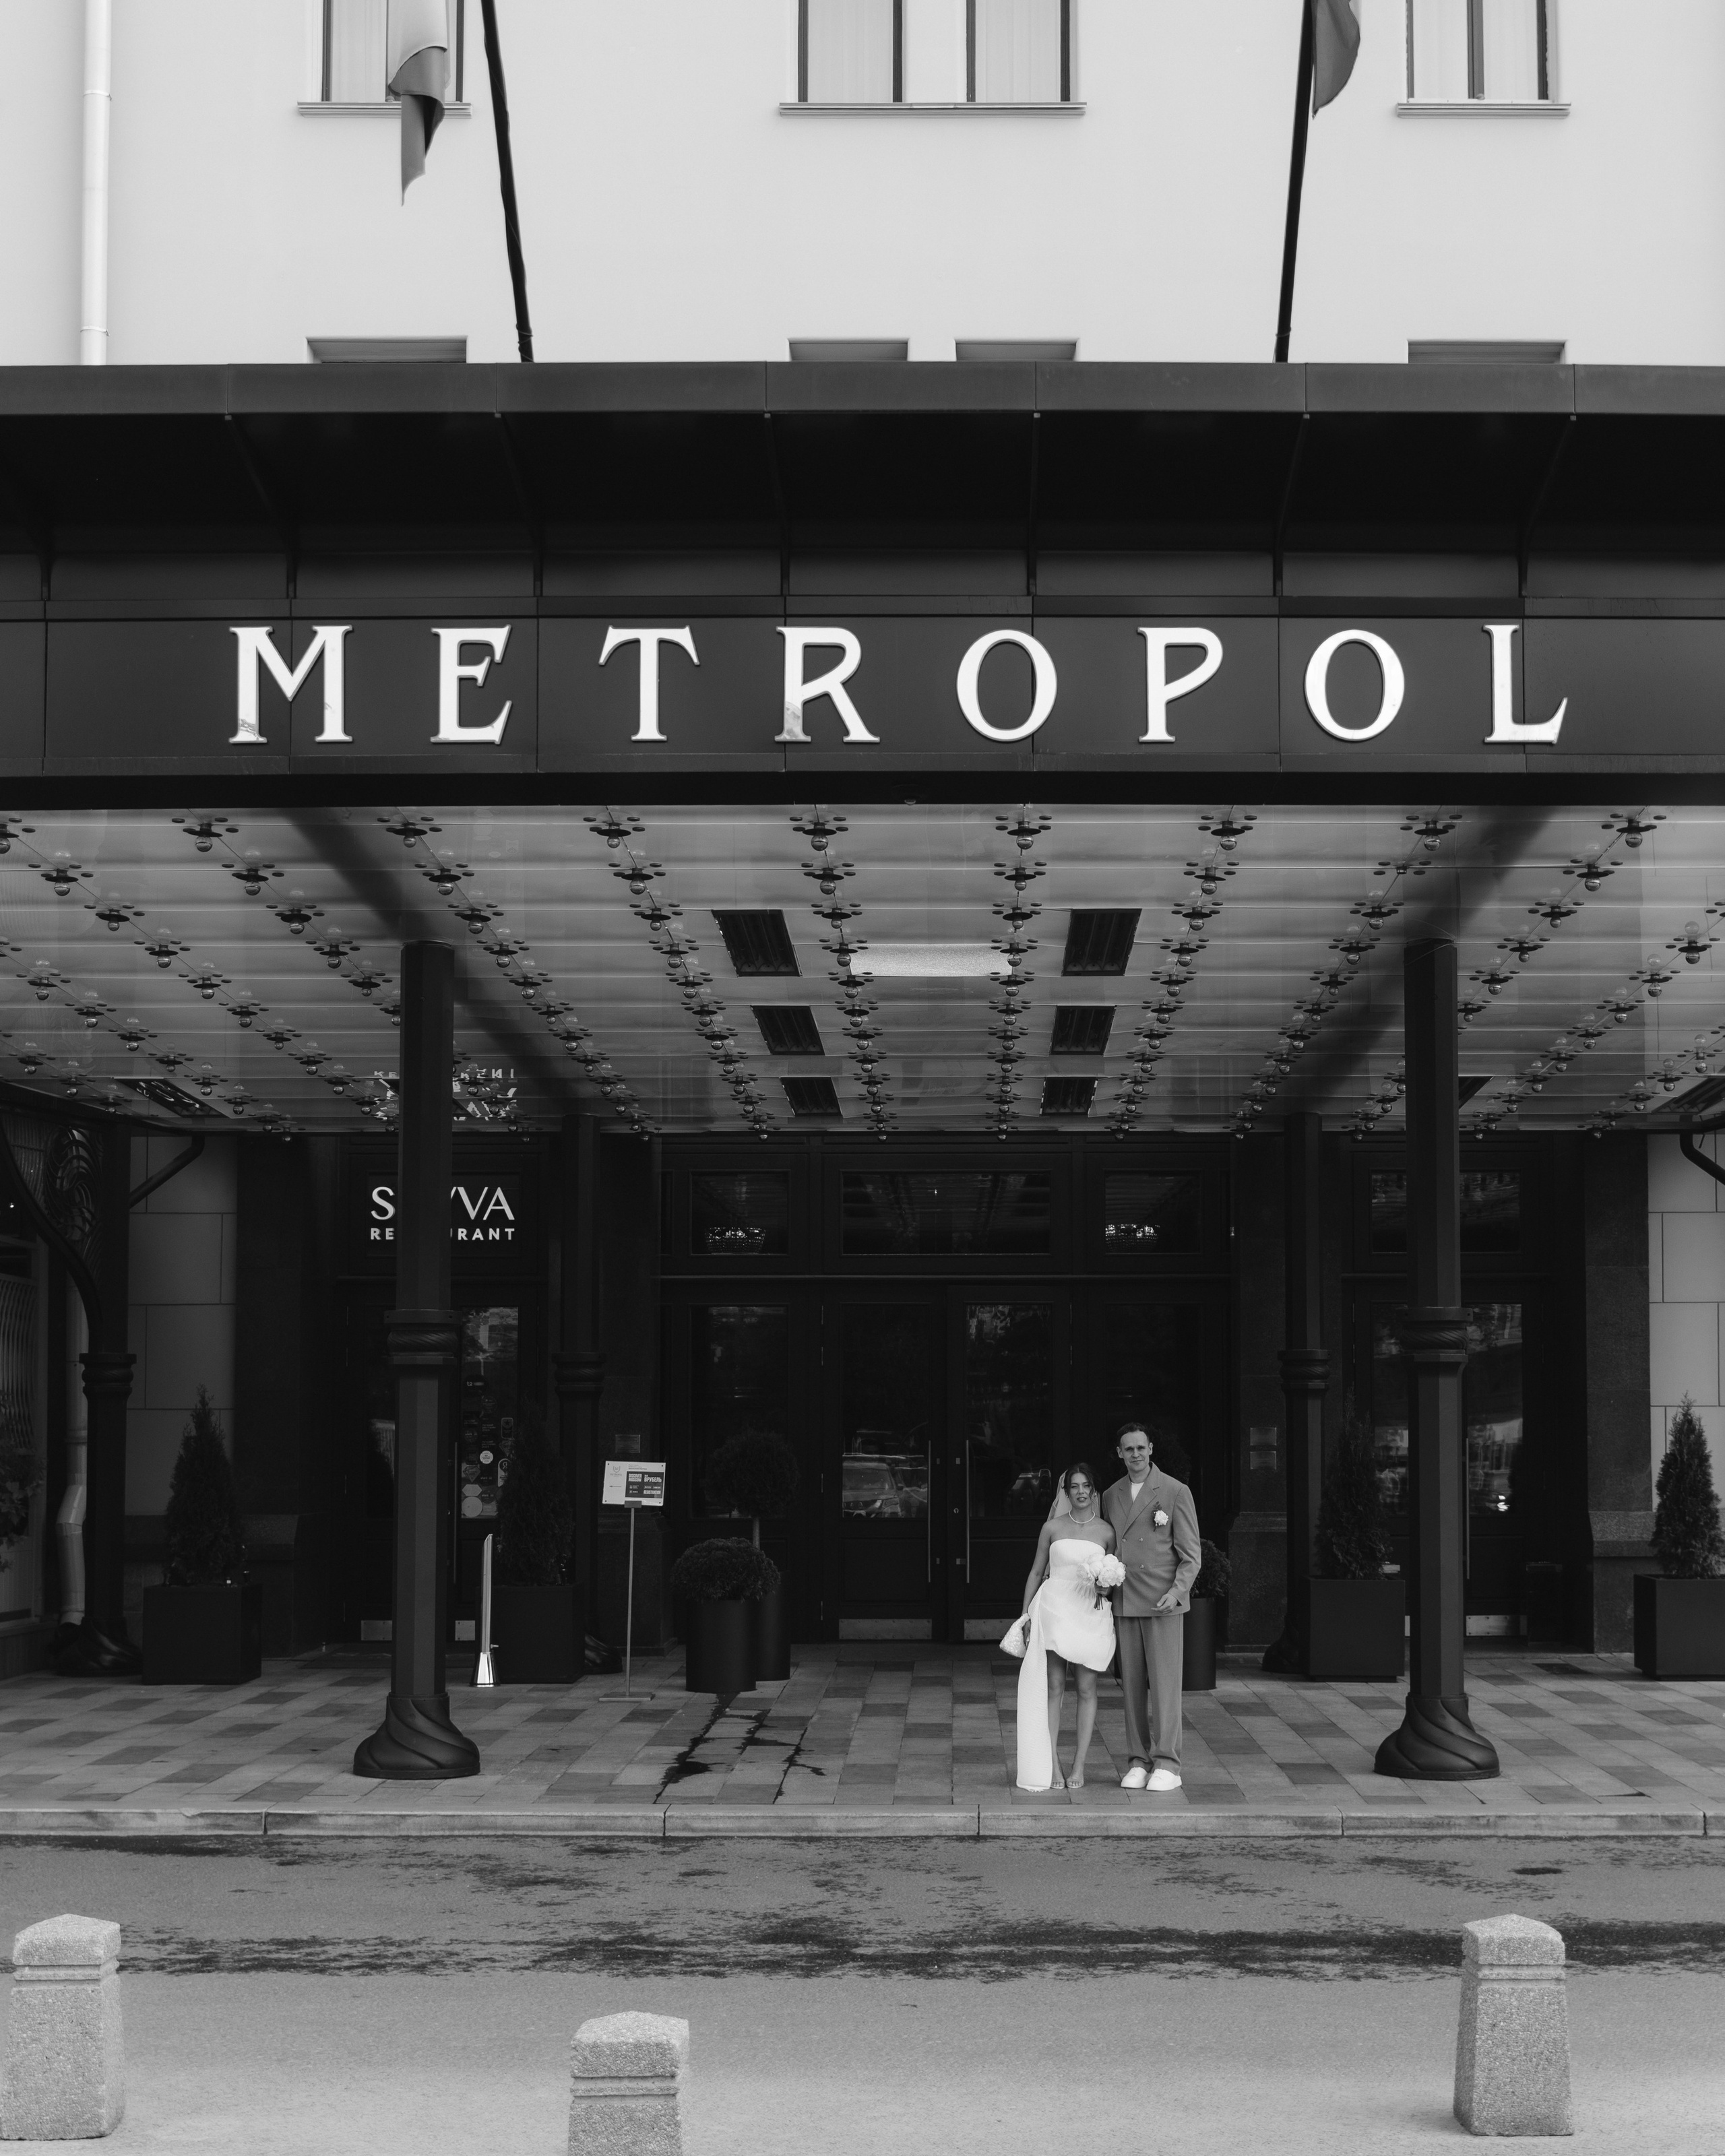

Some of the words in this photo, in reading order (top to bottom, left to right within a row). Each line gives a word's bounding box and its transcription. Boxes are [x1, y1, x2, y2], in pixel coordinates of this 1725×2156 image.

[228, 625, 1568, 744] METROPOL
[371, 1186, 515, 1220] SVA
[370, 1228, 515, 1241] RERANT
